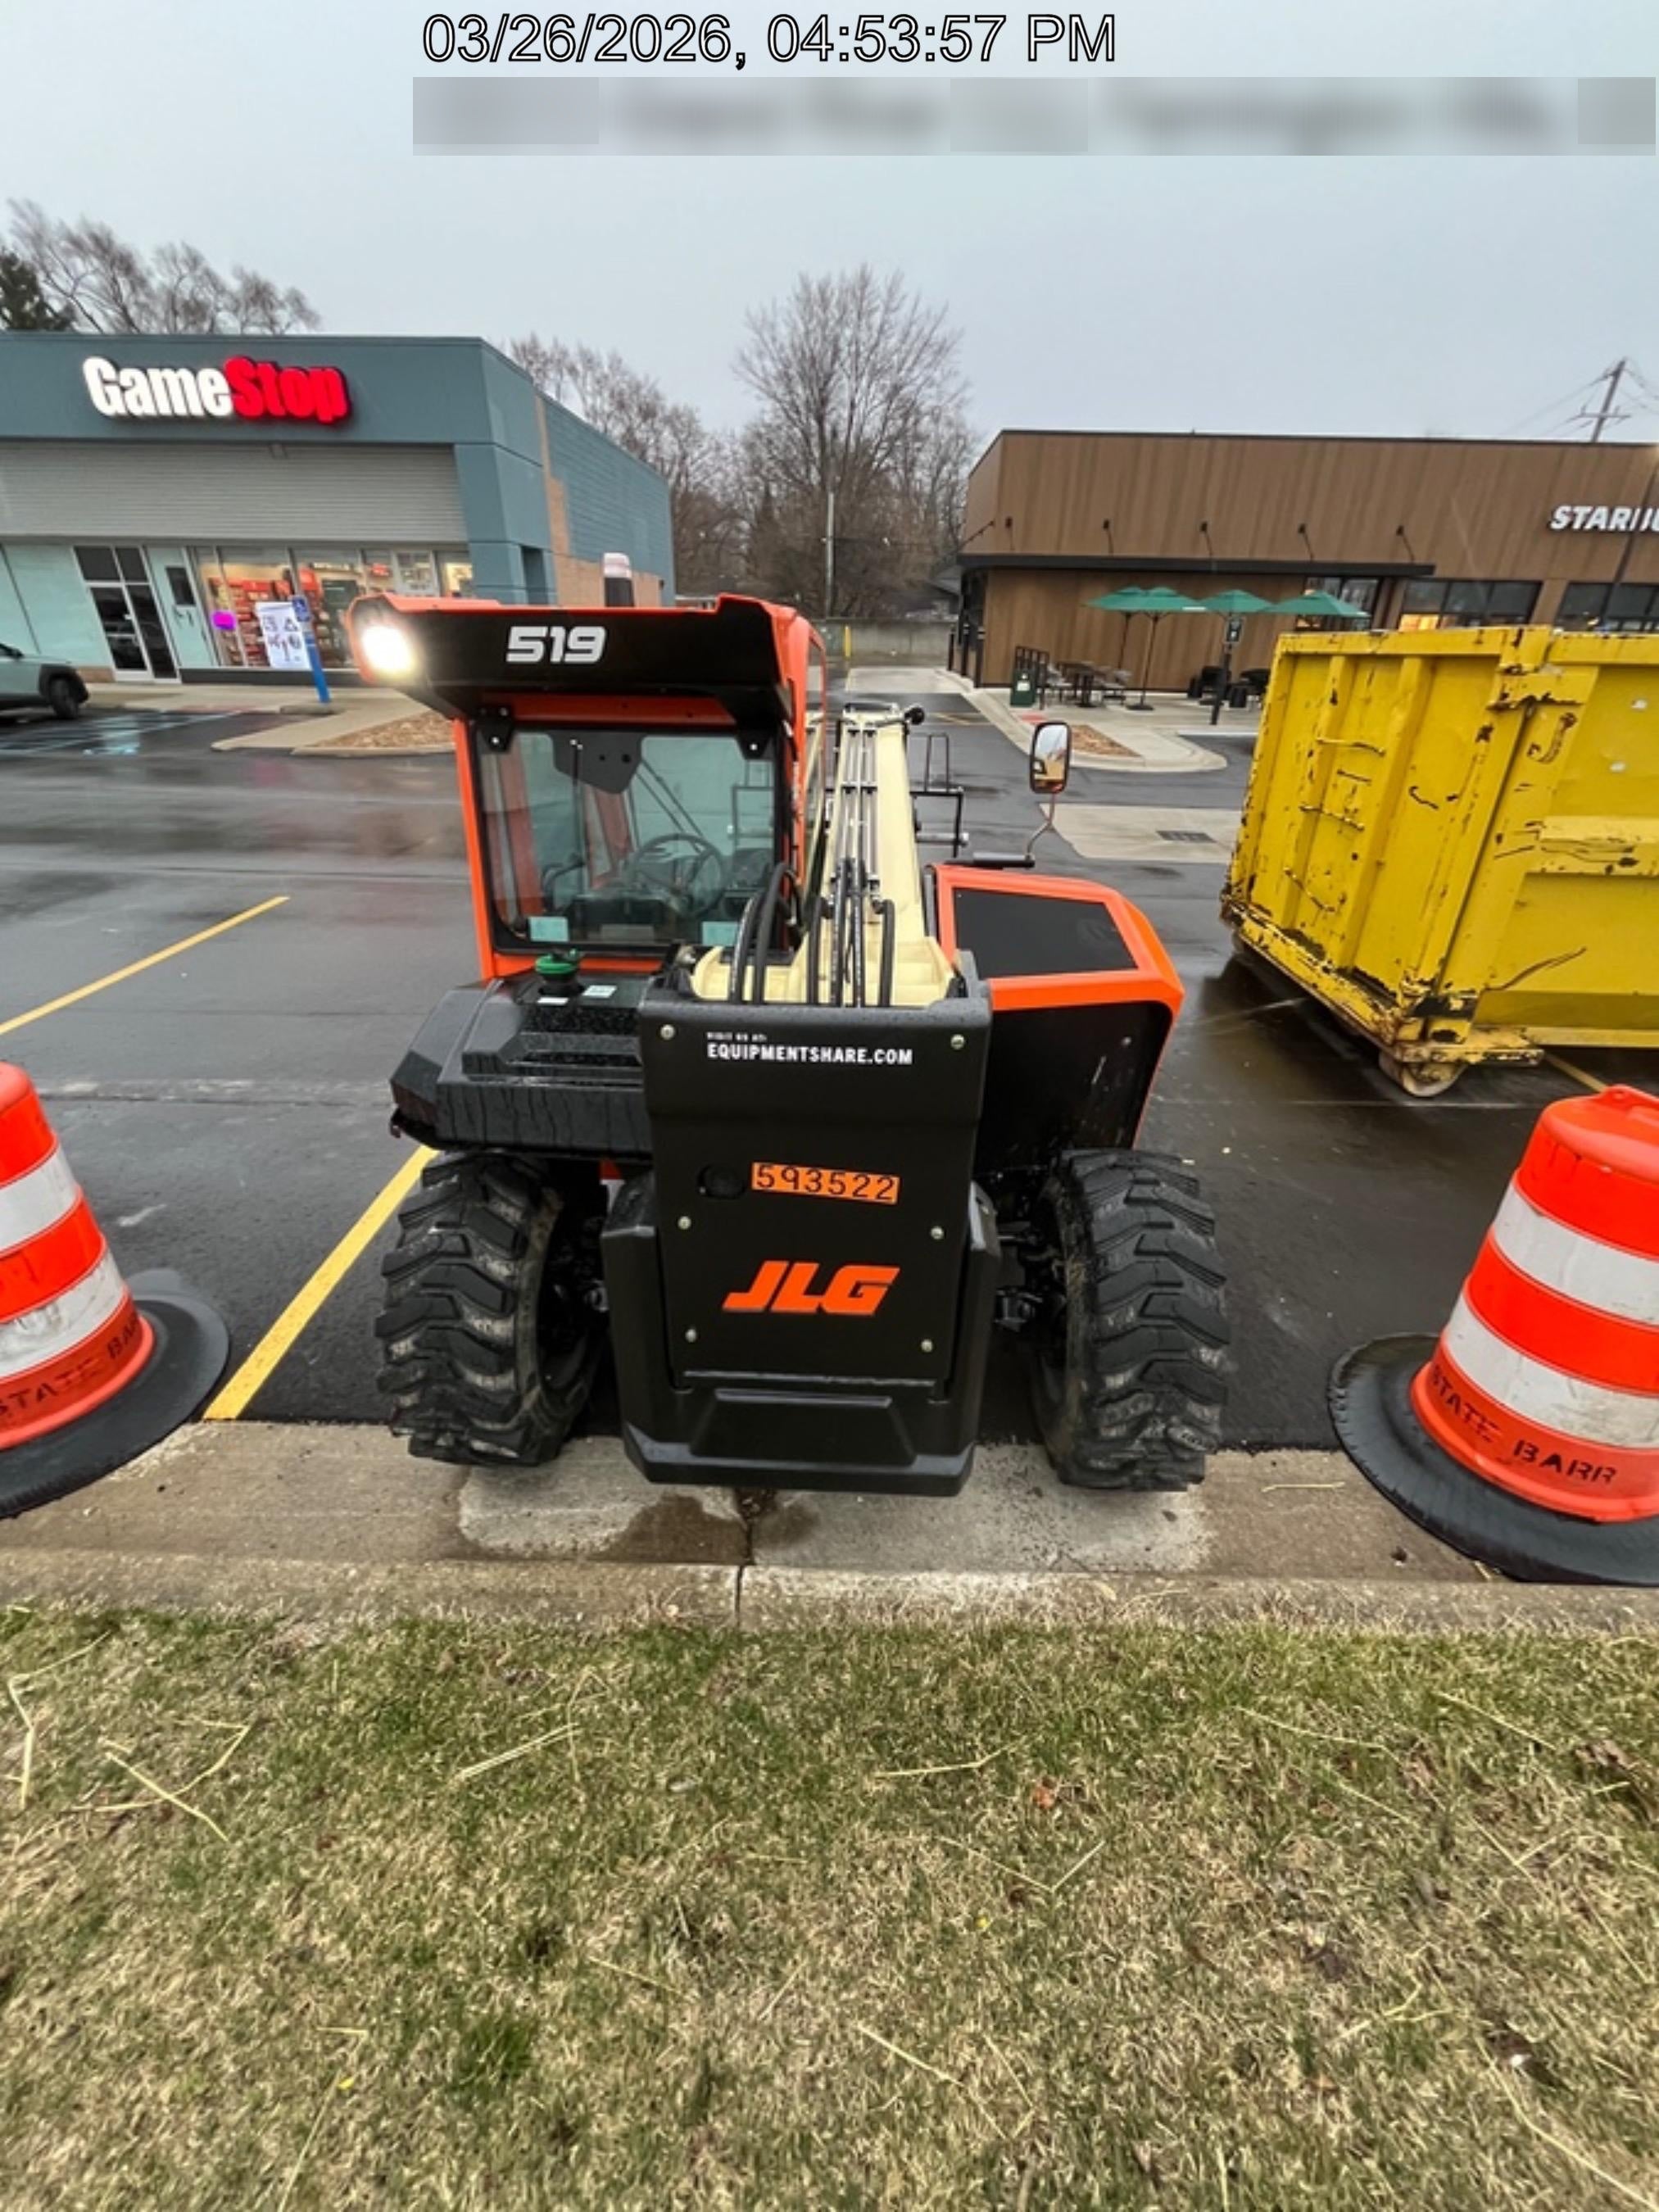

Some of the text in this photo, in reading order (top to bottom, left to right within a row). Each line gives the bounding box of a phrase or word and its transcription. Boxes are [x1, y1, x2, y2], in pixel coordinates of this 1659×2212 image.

[84, 356, 350, 424] GameStop
[505, 626, 606, 663] 519
[706, 1042, 913, 1064] EQUIPMENTSHARE.COM
[756, 1164, 895, 1201] 593522
[722, 1260, 900, 1315] JLG
[1513, 1439, 1617, 1485] BARR
